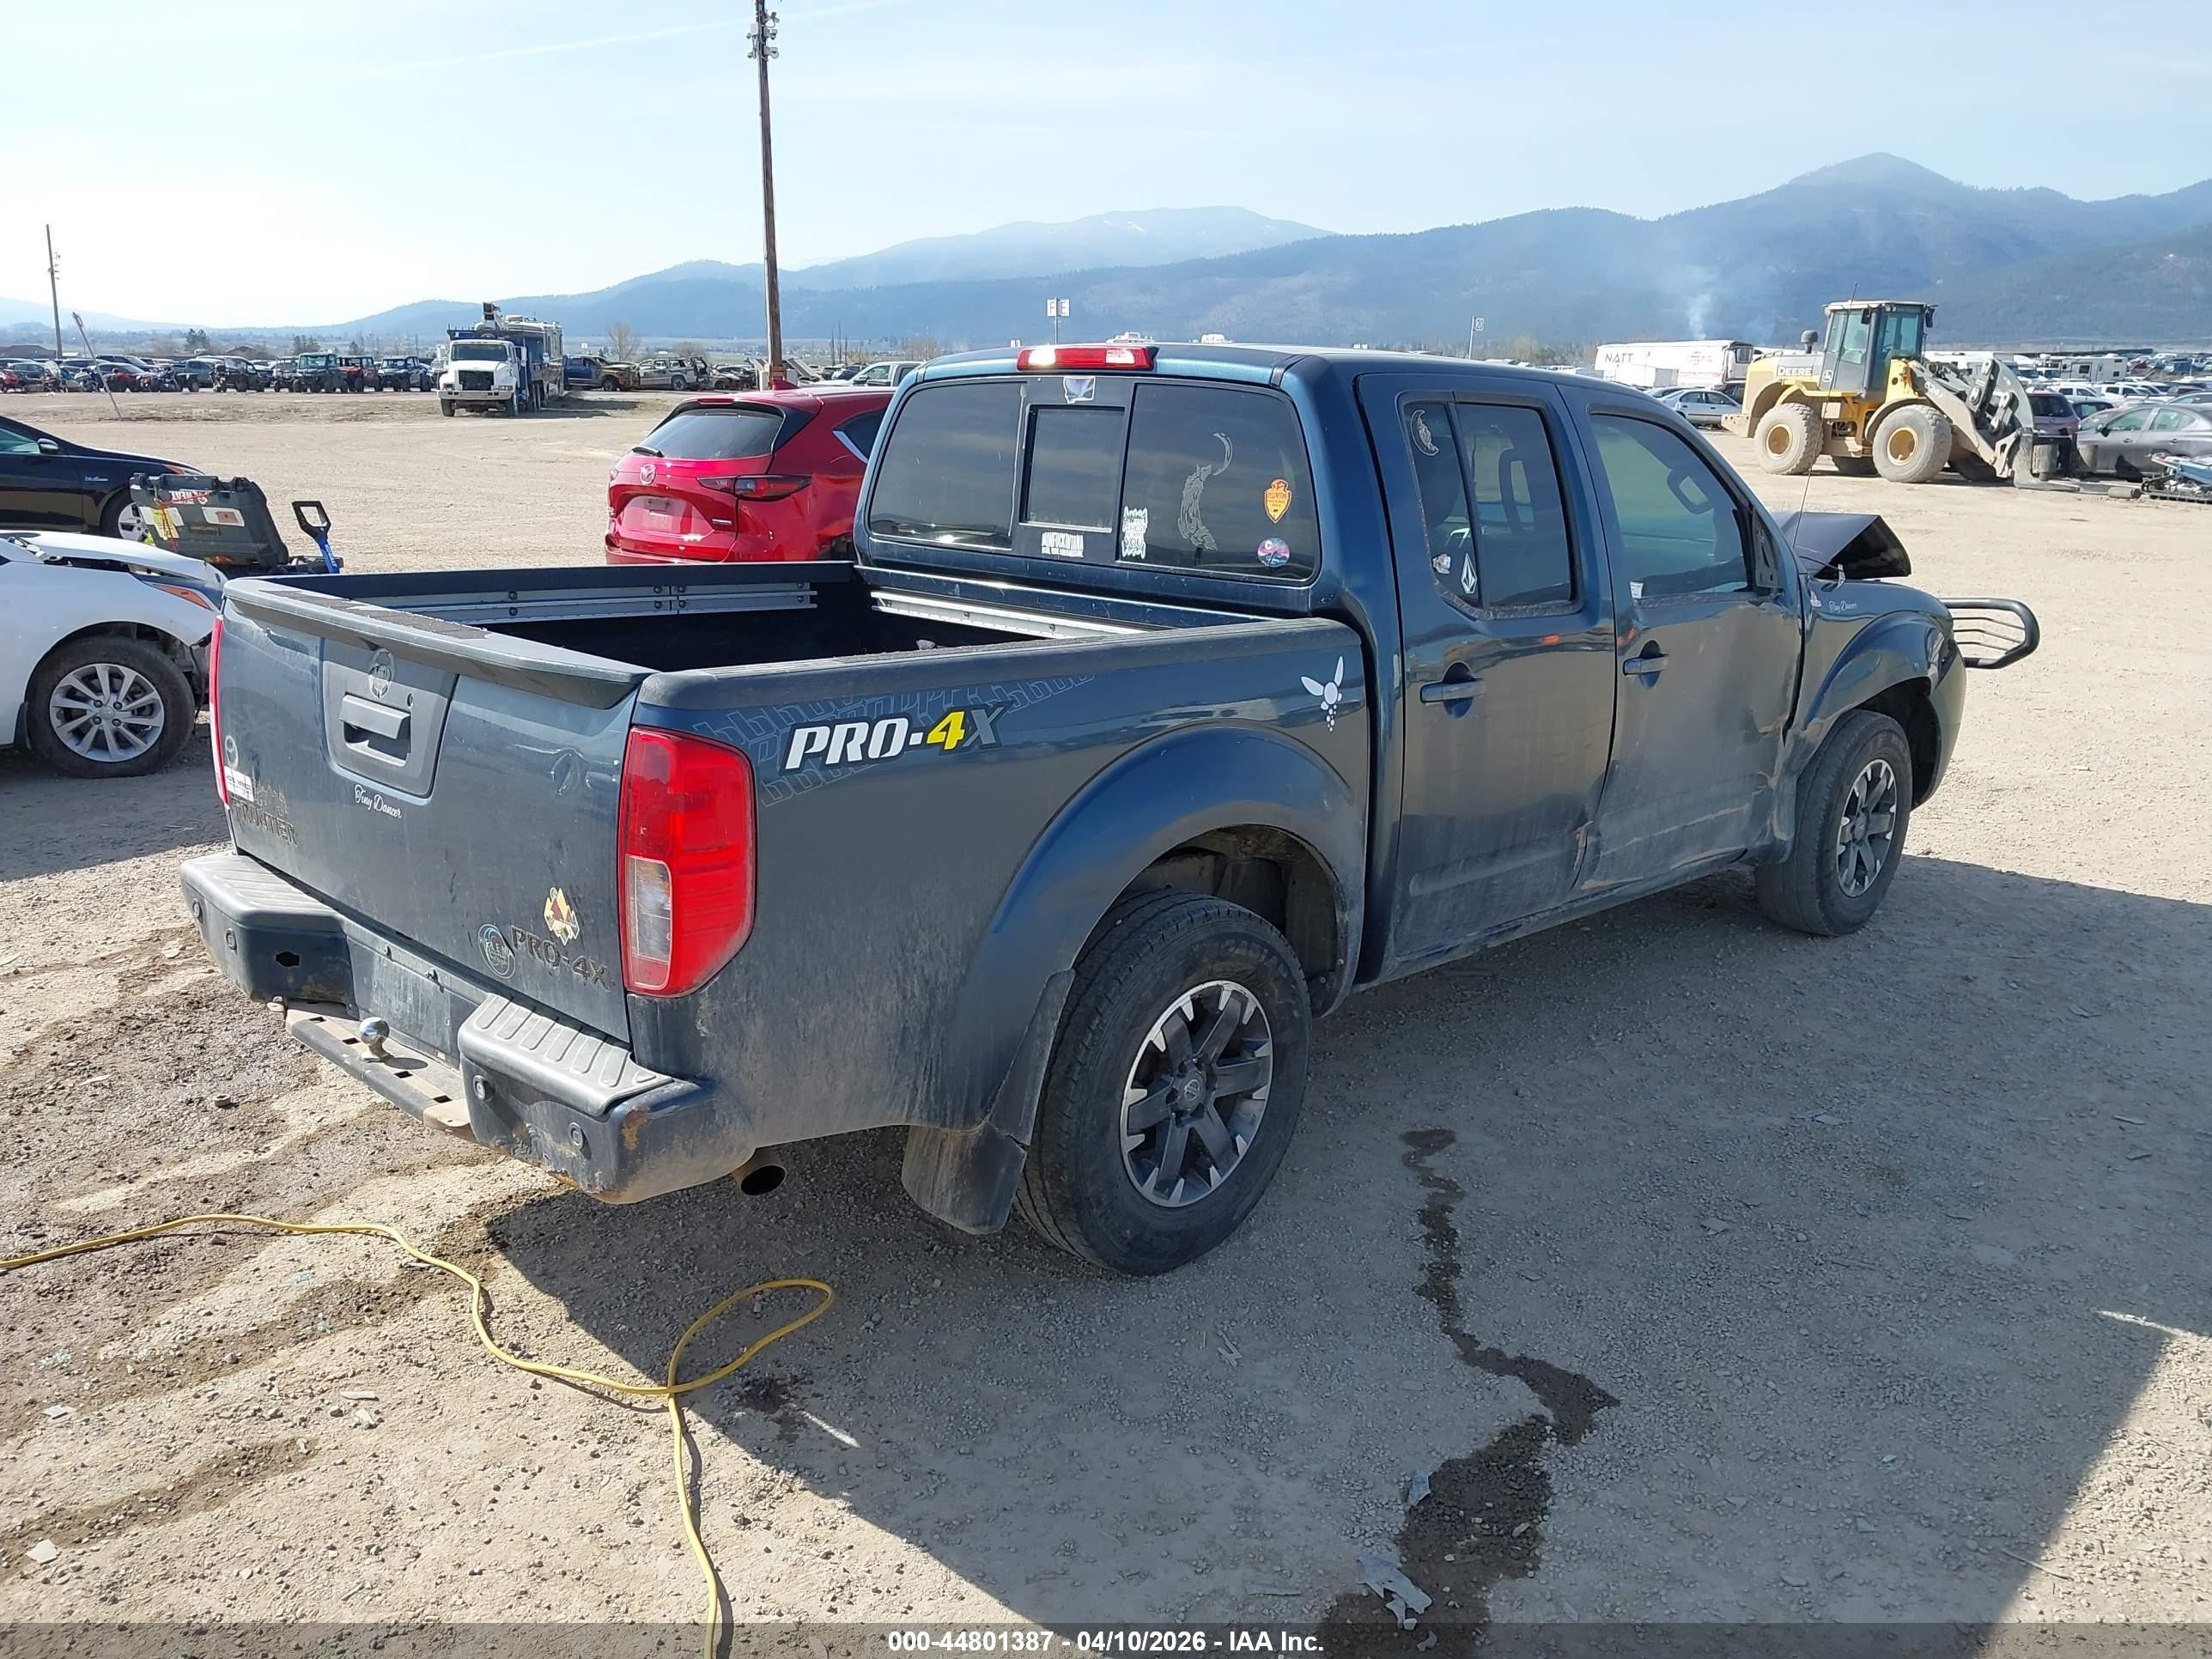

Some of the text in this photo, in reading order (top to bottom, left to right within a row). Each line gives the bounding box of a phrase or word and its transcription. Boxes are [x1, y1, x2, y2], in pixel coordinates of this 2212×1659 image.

[1060, 301, 1067, 315] E
[1605, 352, 1633, 362] NATT
[1778, 366, 1813, 376] DEERE
[784, 705, 1006, 771] PRO-4X
[355, 784, 403, 818] Tiny Dancer
[510, 925, 611, 993] PRO-4X
